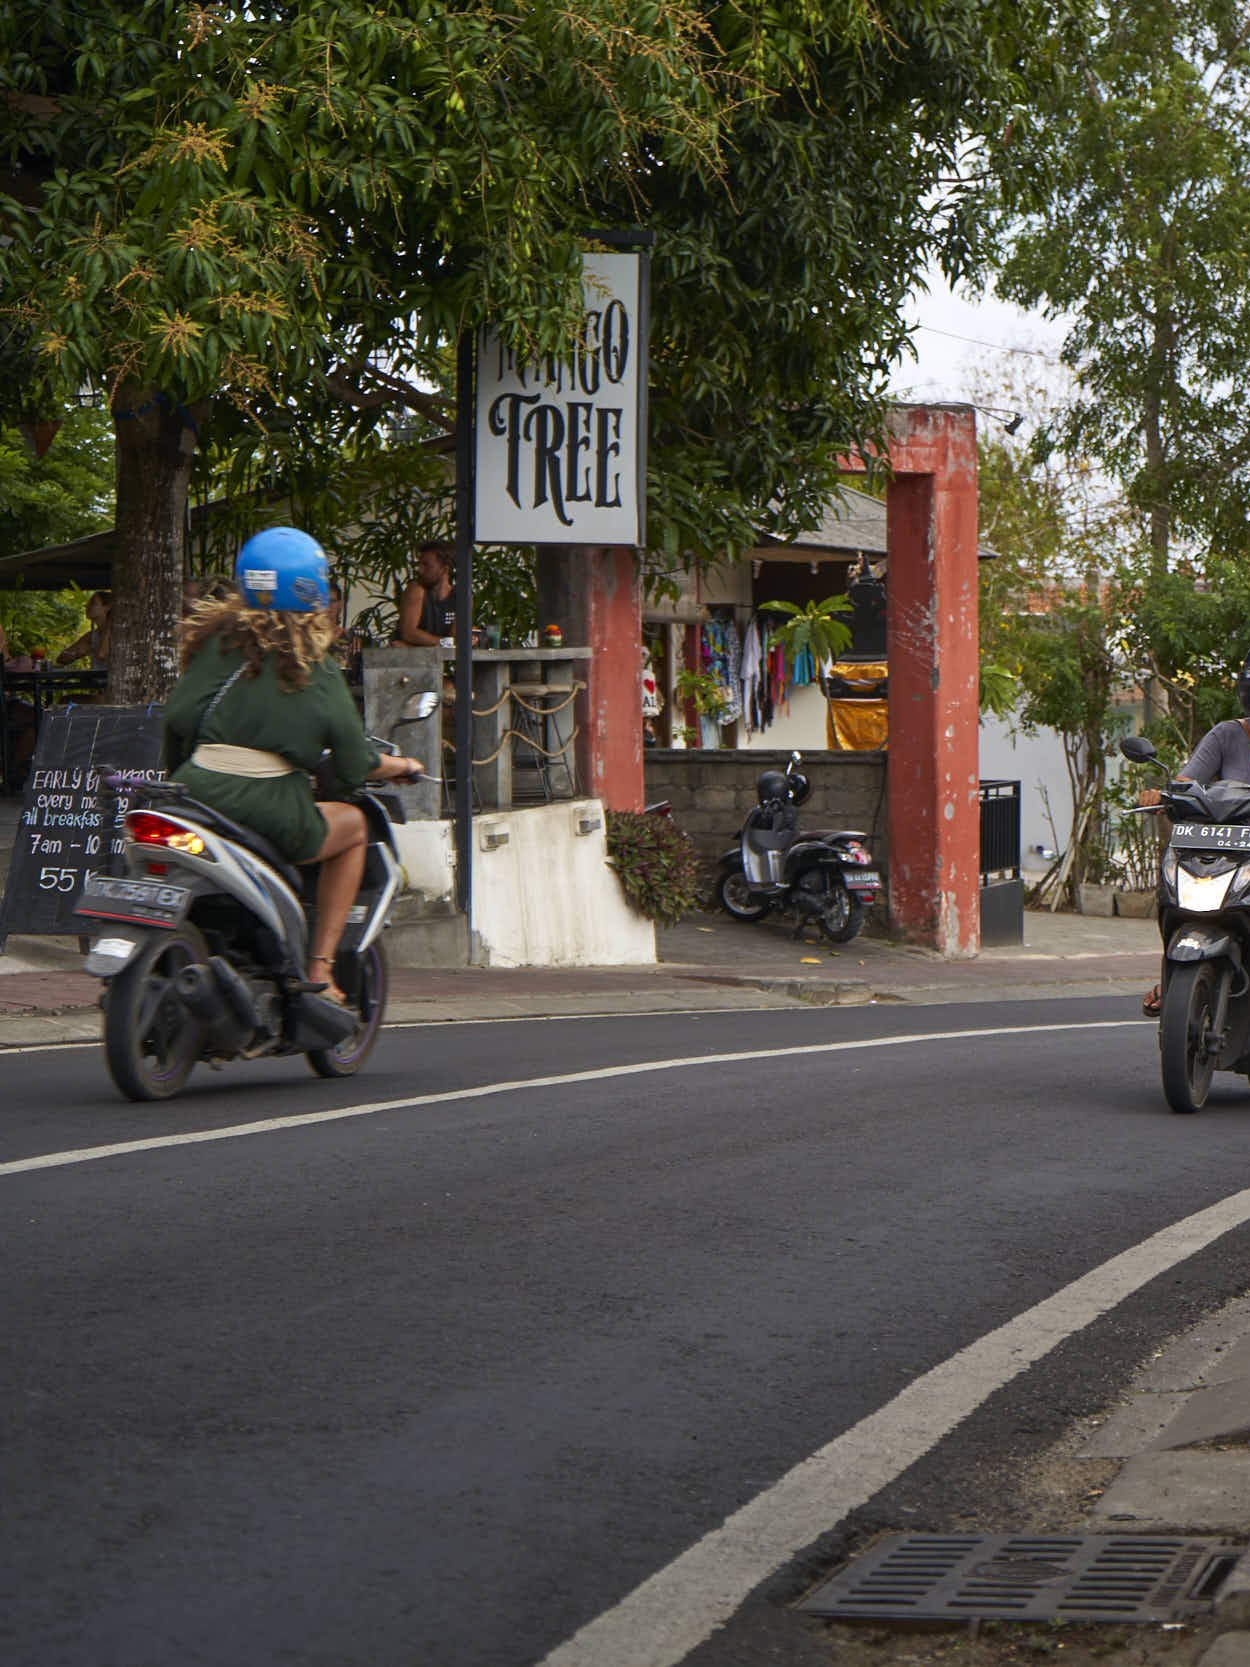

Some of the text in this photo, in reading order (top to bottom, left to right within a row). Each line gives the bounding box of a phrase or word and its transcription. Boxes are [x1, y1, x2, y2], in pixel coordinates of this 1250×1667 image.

[488, 393, 624, 526] TREE
[32, 767, 81, 790] EARLY
[37, 793, 73, 810] every
[43, 807, 104, 829] breakfas
[1176, 825, 1194, 836] DK
[1201, 826, 1232, 838] 6141
[84, 834, 100, 855] 10
[39, 866, 79, 892] 55
